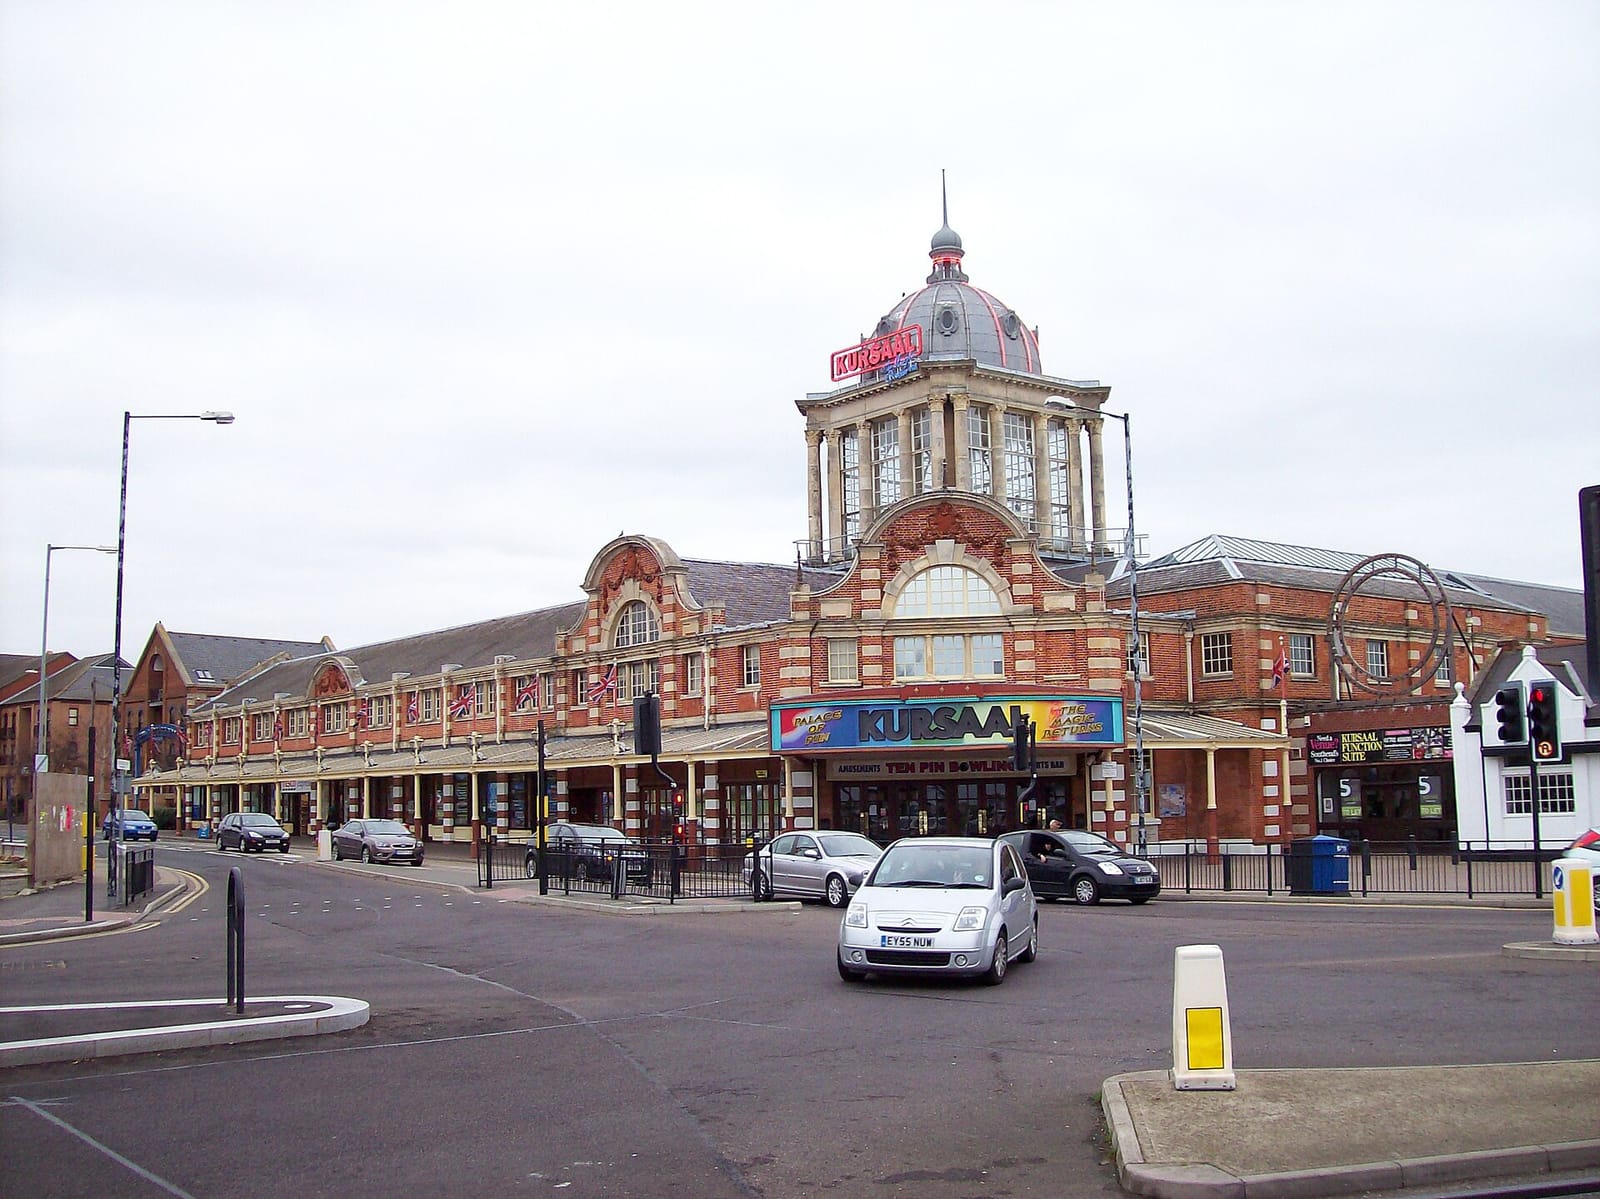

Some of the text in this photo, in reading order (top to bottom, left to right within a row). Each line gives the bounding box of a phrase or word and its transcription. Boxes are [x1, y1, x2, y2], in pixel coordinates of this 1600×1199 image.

[836, 332, 916, 375] KURSAAL
[1060, 704, 1087, 715] THE
[794, 709, 843, 726] PALACE
[1050, 713, 1096, 728] MAGIC
[808, 723, 825, 734] OF
[1041, 722, 1103, 739] RETURNS
[1341, 732, 1379, 743] KURSAAL
[1310, 738, 1339, 750] Venue?
[1341, 741, 1383, 753] FUNCTION
[1342, 752, 1367, 762] SUITE
[838, 764, 881, 773] AMUSEMENTS
[886, 761, 916, 774] TEN
[919, 761, 945, 773] PIN
[1340, 779, 1352, 797] 5
[1419, 776, 1431, 795] 5
[887, 936, 912, 946] EY55
